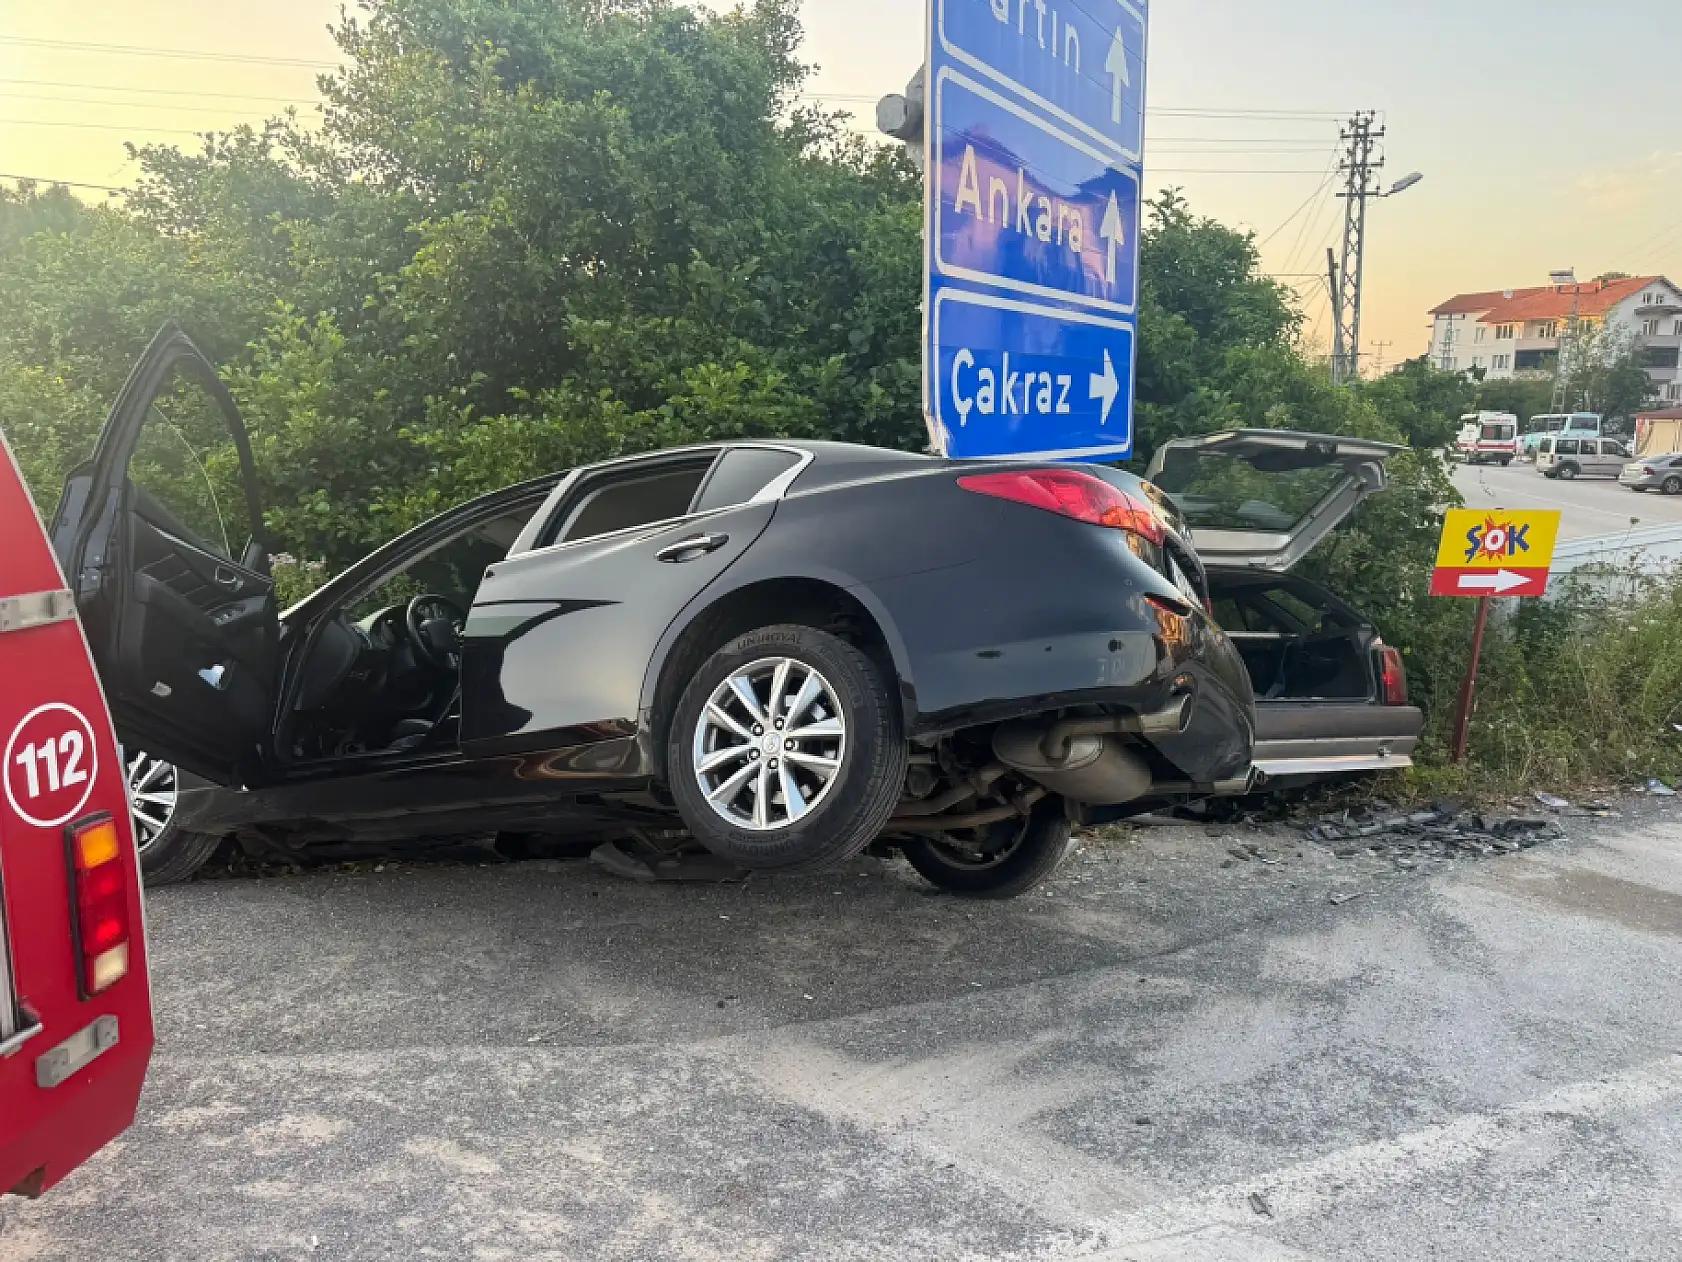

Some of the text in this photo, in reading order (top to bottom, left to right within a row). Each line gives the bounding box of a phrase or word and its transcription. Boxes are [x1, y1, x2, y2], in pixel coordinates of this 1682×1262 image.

[955, 144, 1083, 253] Ankara
[951, 347, 1072, 426] Çakraz
[16, 730, 87, 799] 112
